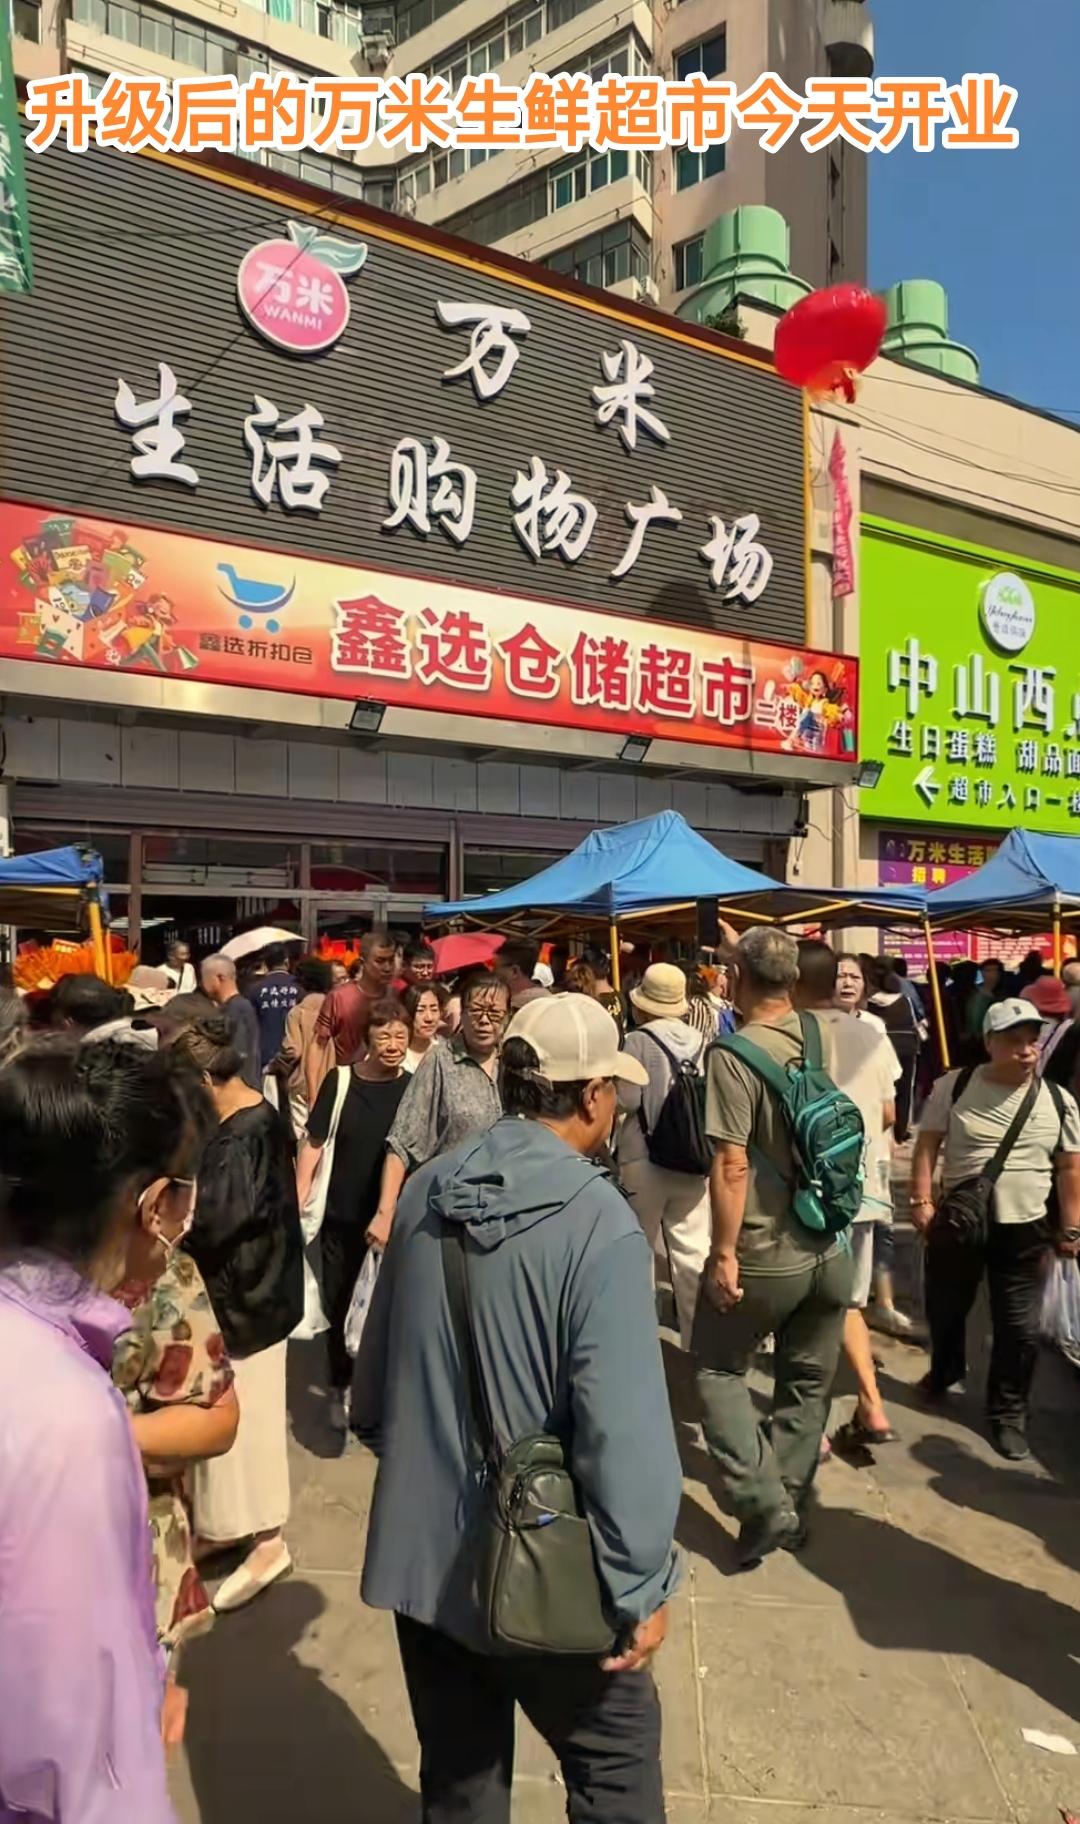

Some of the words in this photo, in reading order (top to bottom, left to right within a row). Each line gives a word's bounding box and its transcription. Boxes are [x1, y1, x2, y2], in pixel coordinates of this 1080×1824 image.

[255, 261, 333, 316] 万米
[264, 304, 323, 331] WANMI
[435, 300, 672, 450] 万米
[114, 361, 776, 605] 生活购物广场
[335, 594, 755, 724] 鑫选仓储超市
[889, 720, 998, 768] 生日蛋糕
